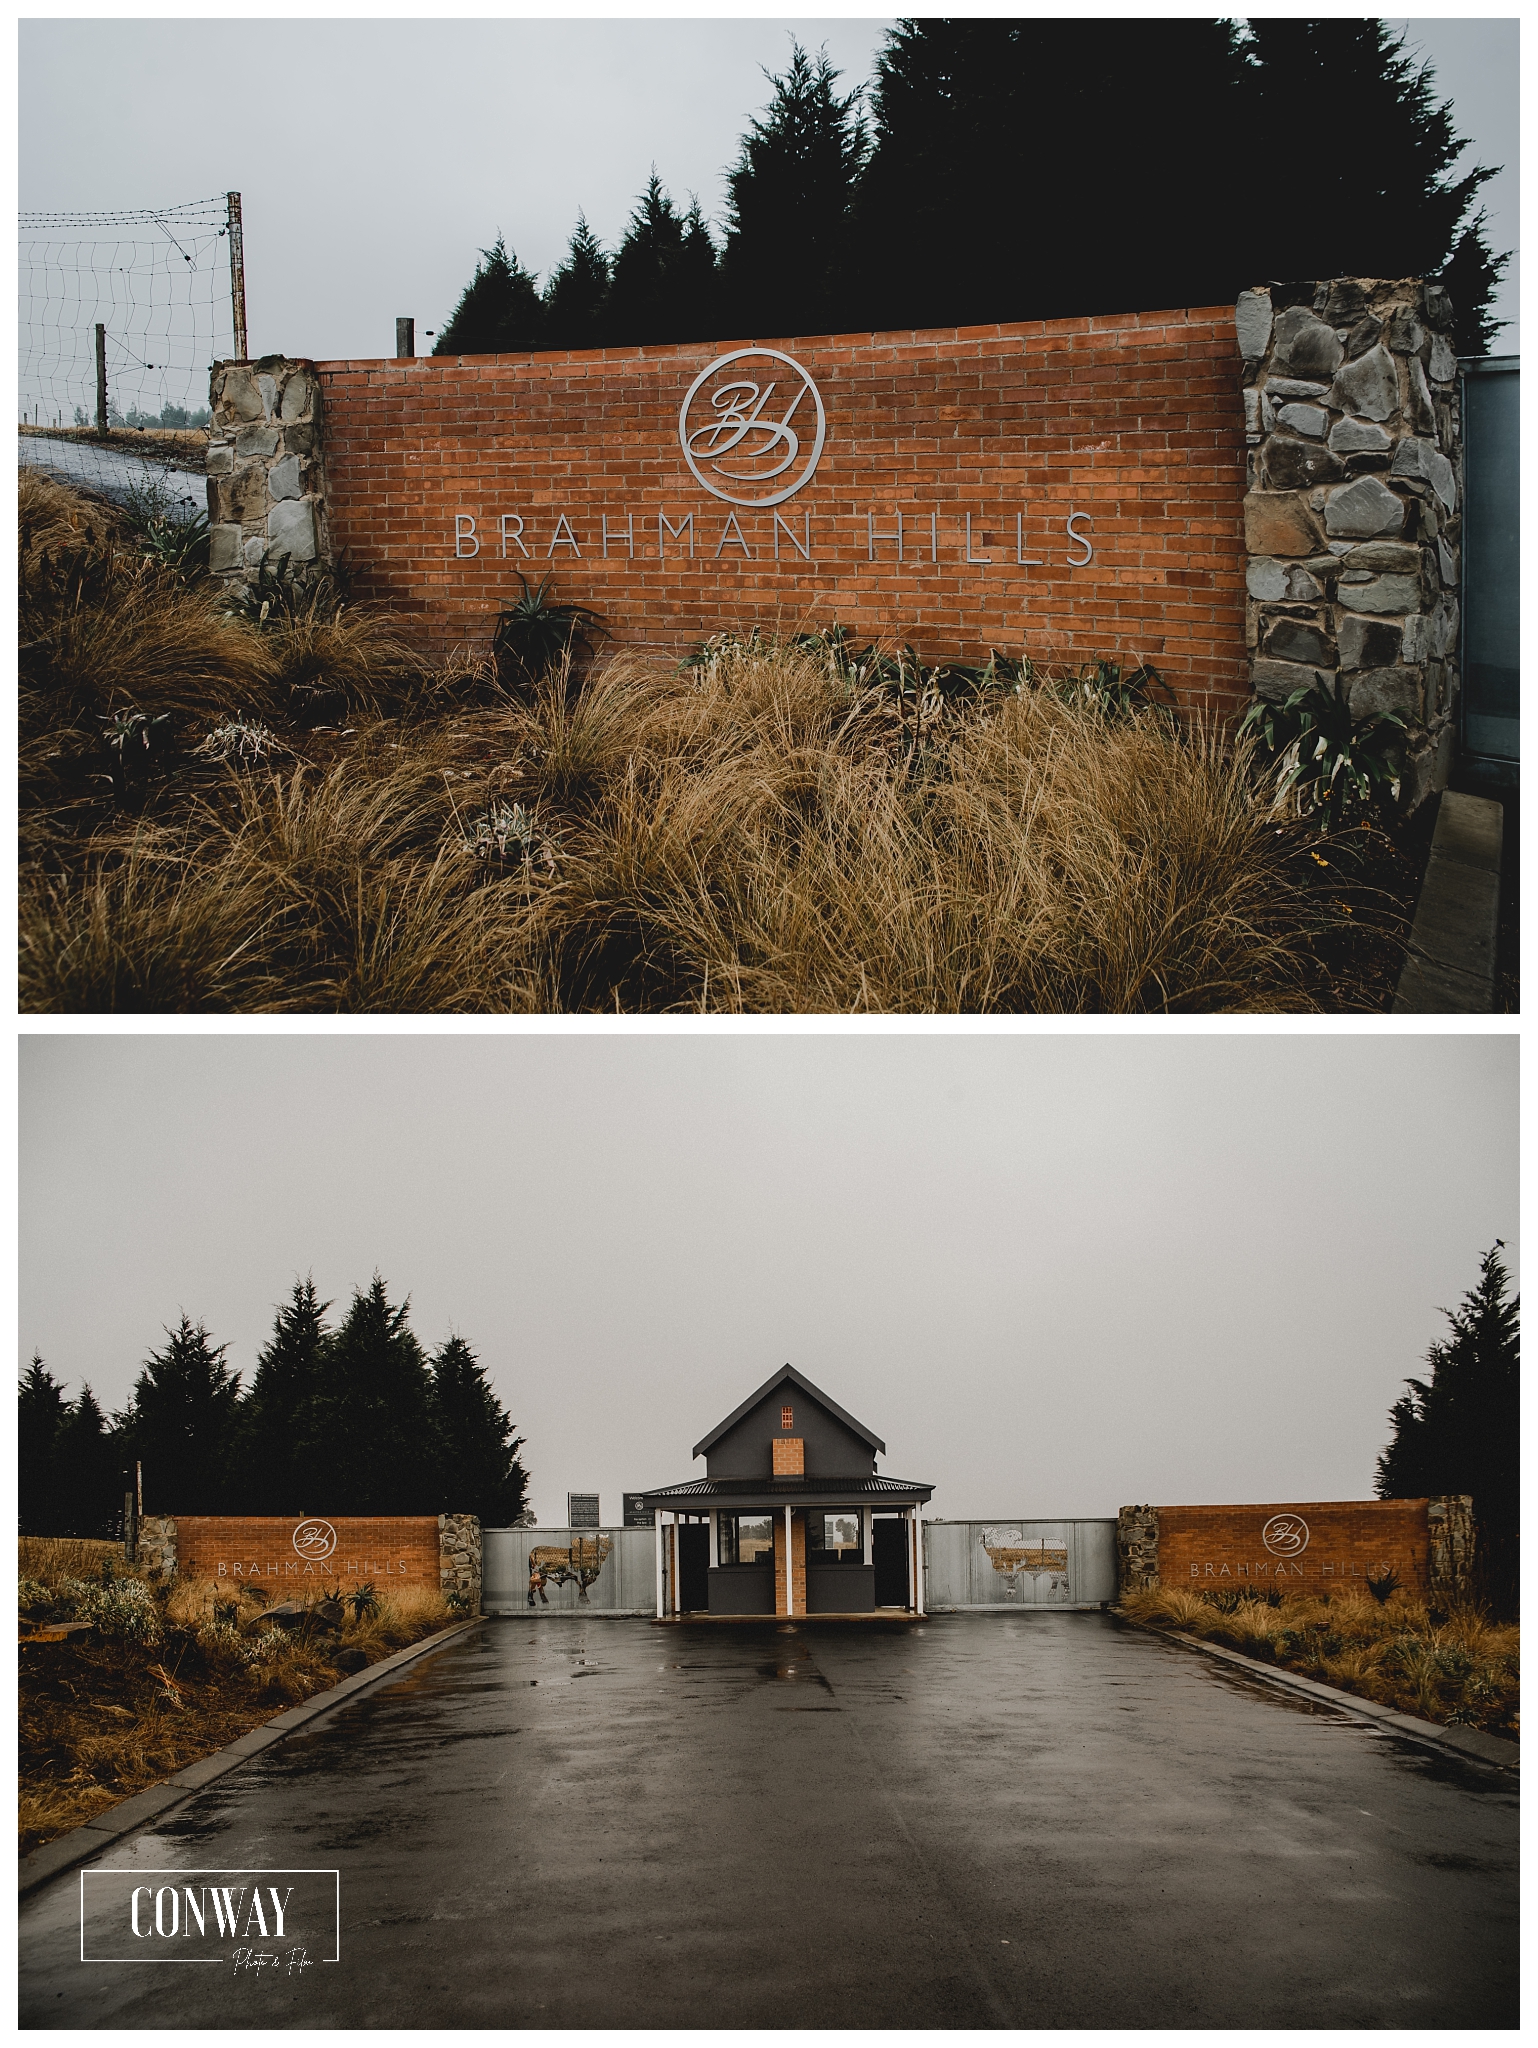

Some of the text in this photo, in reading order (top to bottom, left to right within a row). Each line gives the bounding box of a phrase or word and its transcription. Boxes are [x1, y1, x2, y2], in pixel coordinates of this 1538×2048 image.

[455, 511, 1094, 567] BRAHMAN HILLS
[218, 1560, 407, 1576] BRAHMAN HILLS
[1190, 1561, 1391, 1577] BRAHMAN HILLS
